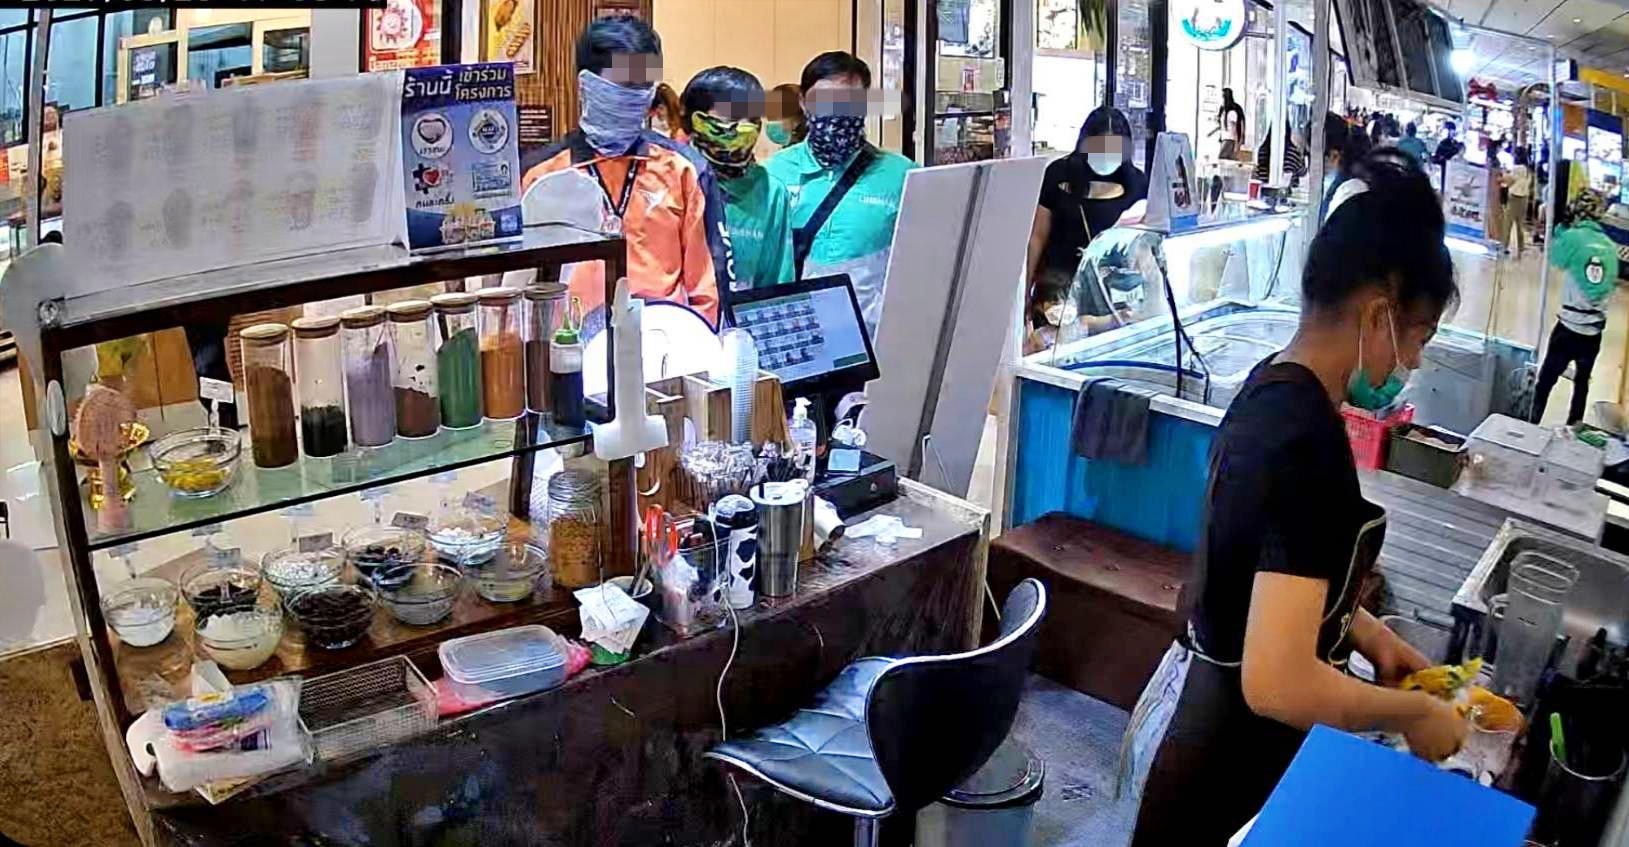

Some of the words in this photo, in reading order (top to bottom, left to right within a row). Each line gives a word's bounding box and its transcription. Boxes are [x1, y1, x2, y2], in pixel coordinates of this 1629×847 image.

[459, 65, 507, 83] เข้าร่วม
[404, 69, 453, 98] ร้านนี้
[455, 83, 512, 100] โครงการ
